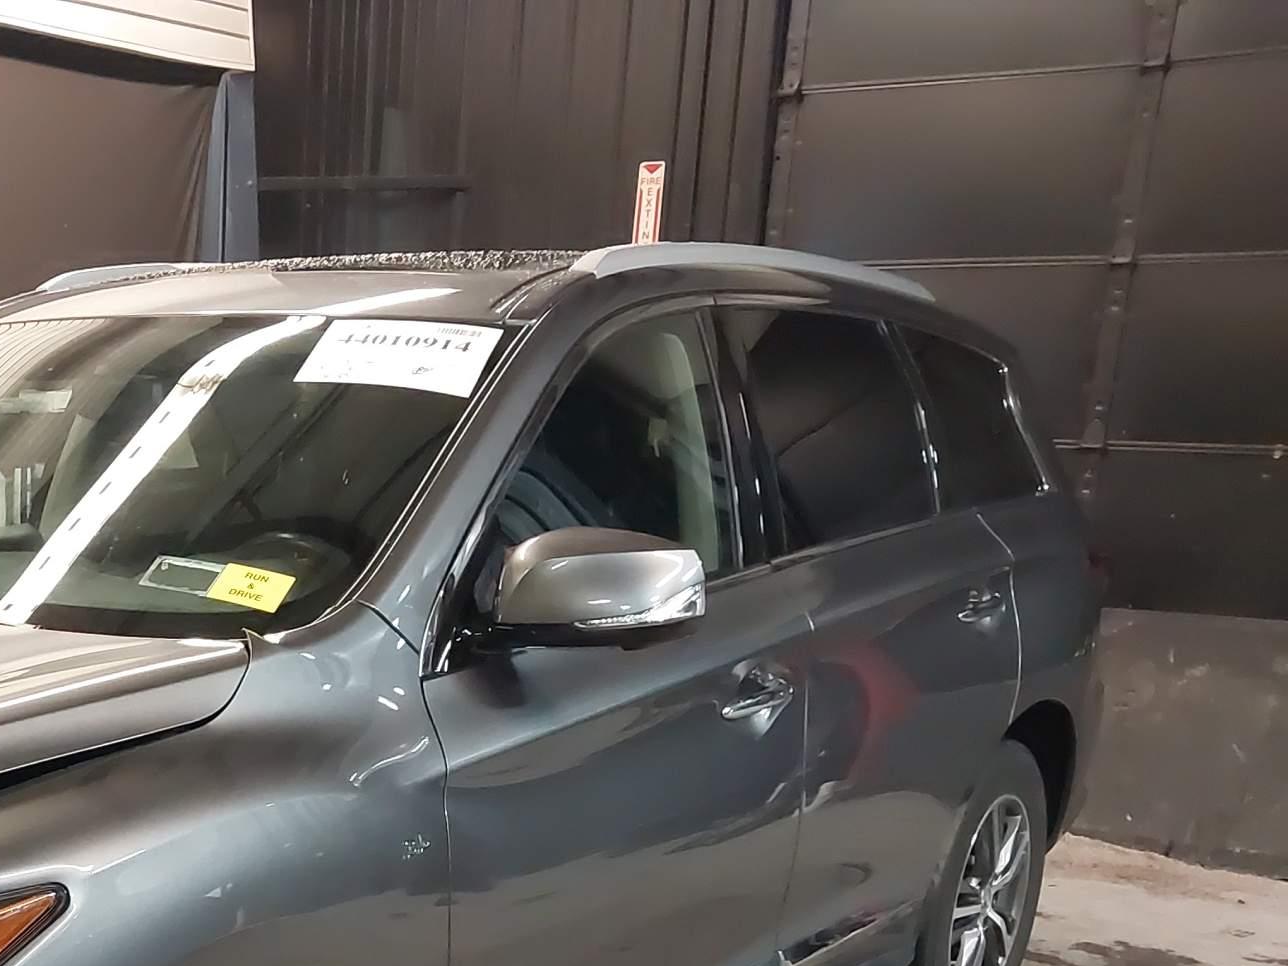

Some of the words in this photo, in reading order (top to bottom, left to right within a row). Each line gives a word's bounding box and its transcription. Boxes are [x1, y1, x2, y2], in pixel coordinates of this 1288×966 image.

[640, 177, 661, 185] FIRE
[642, 187, 653, 243] EXTIN
[337, 332, 472, 352] 44010914
[244, 571, 269, 583] RUN
[228, 588, 263, 602] DRIVE
